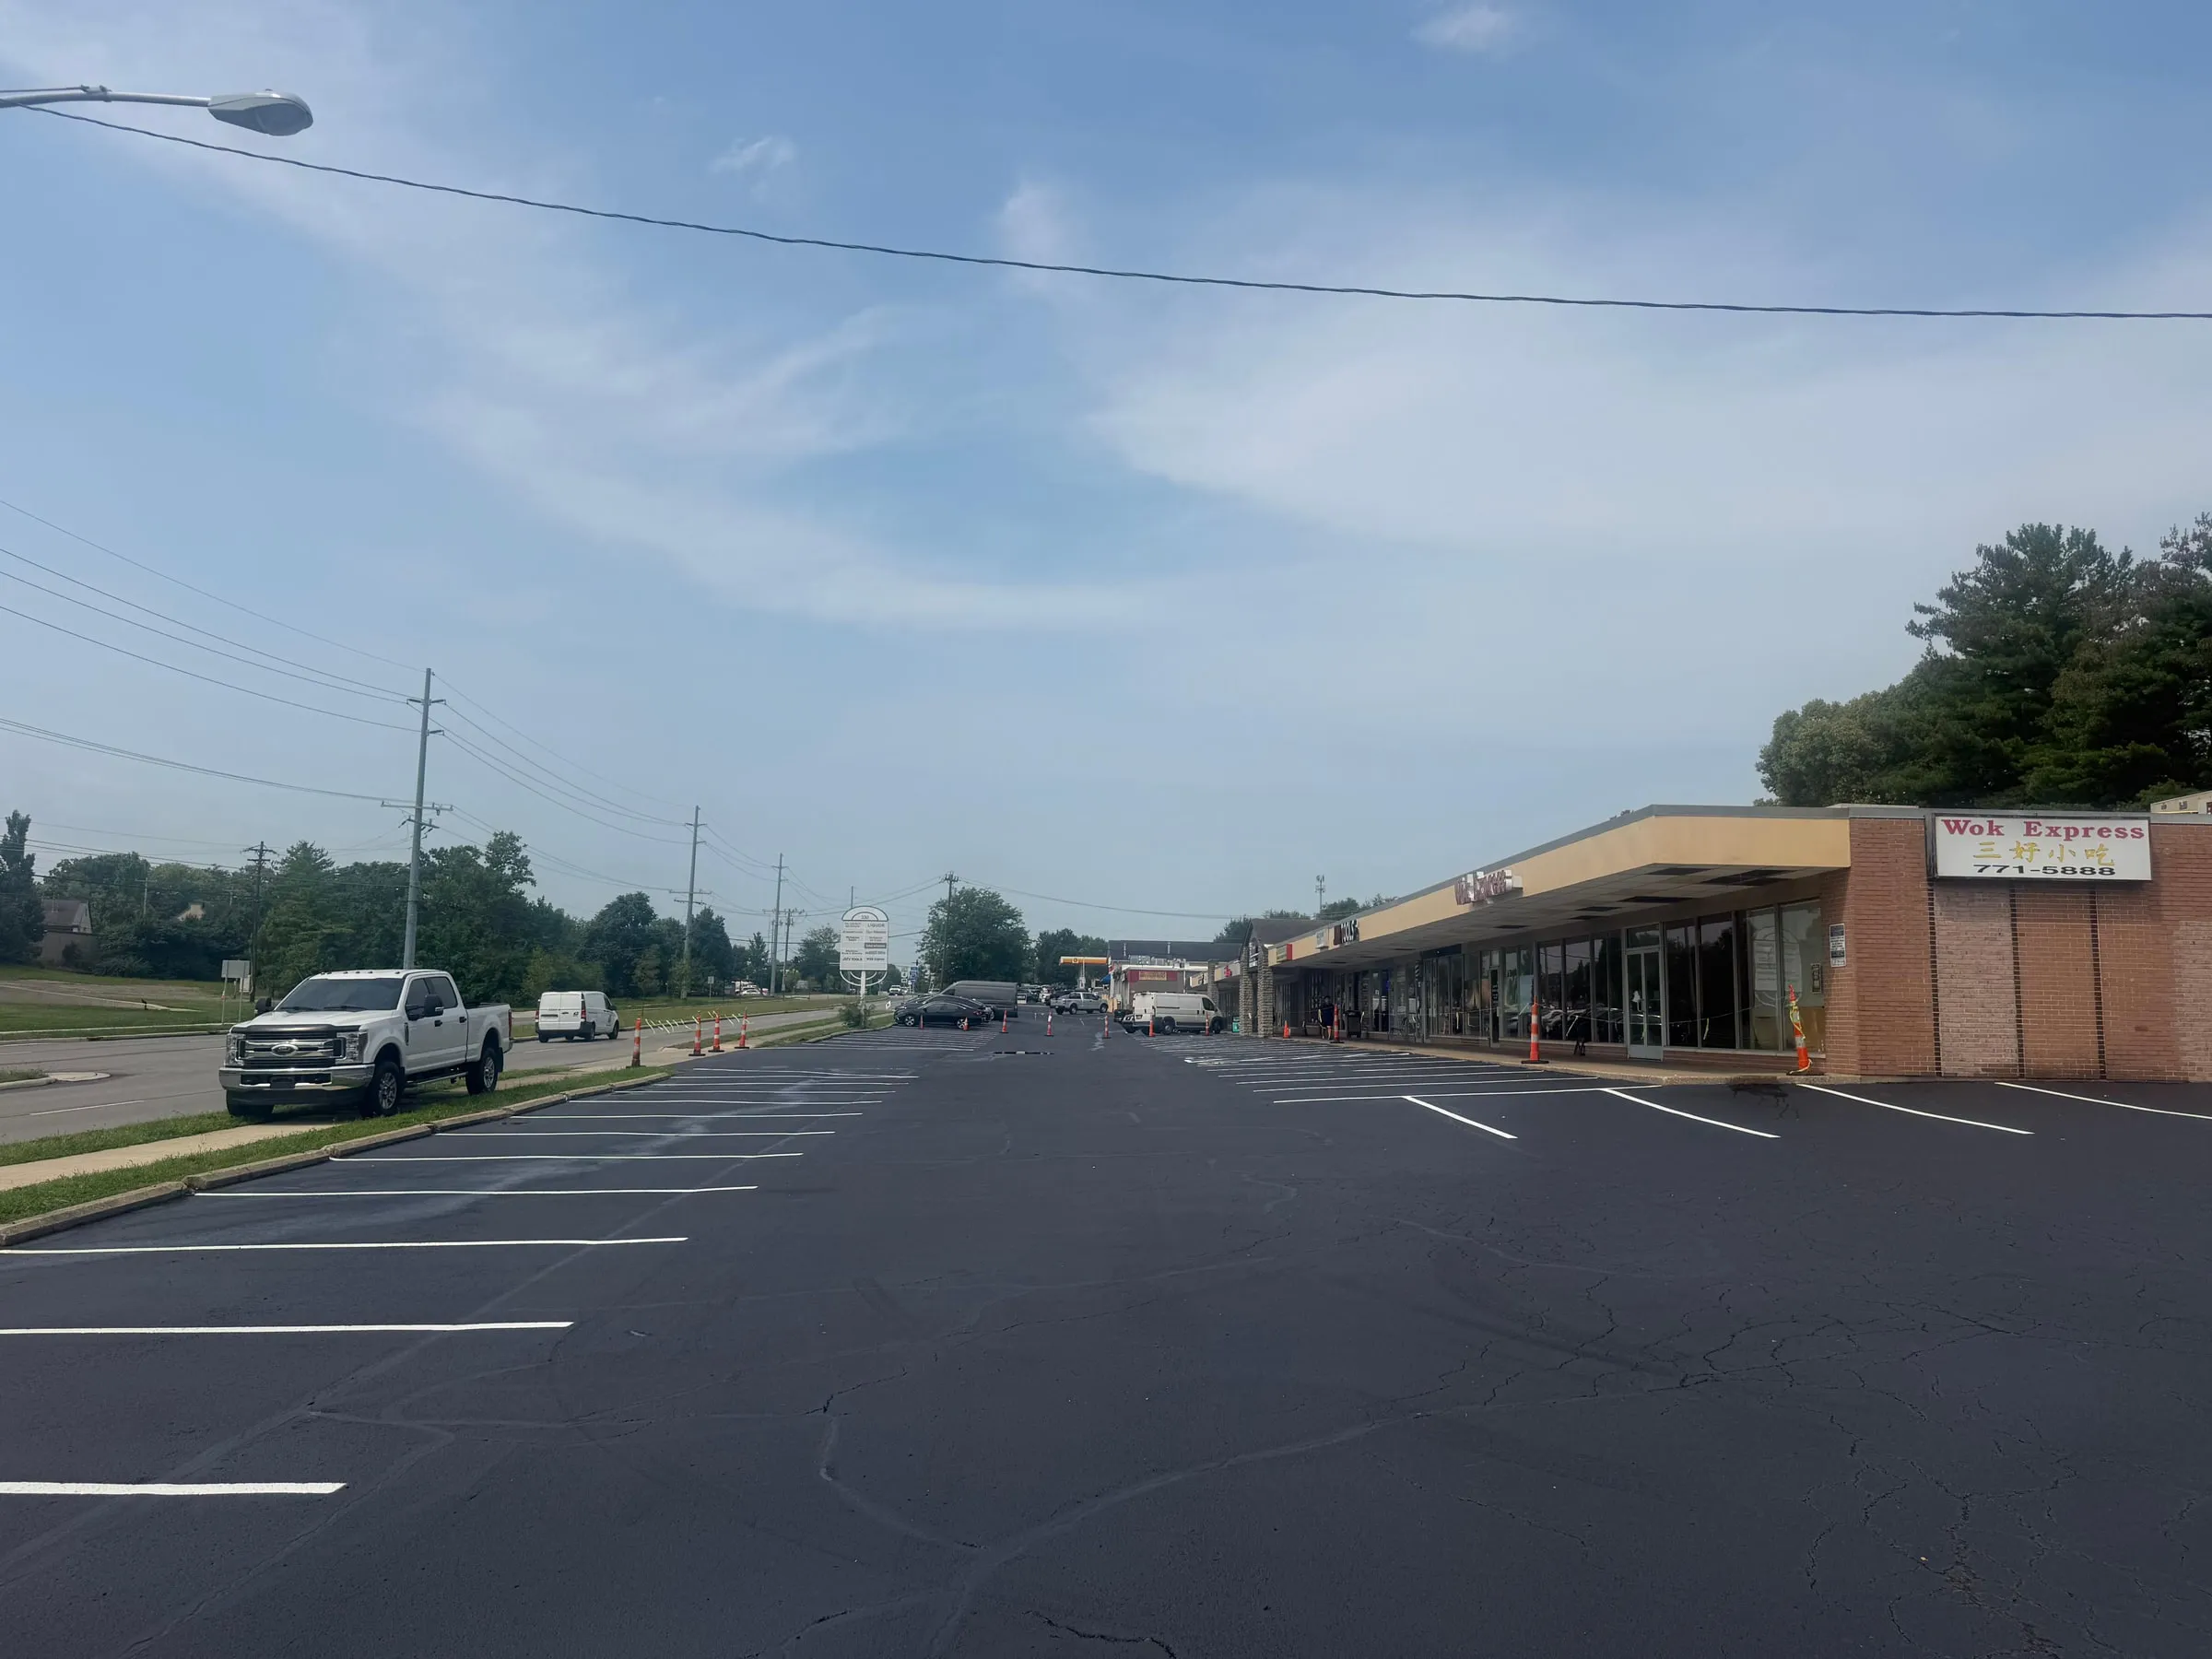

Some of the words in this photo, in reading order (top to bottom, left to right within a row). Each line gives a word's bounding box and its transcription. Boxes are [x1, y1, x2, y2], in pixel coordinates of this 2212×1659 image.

[1941, 818, 2005, 837] Wok
[2023, 820, 2146, 841] Express
[1973, 841, 2115, 866] 三好小吃
[1973, 865, 2116, 877] 771-5888
